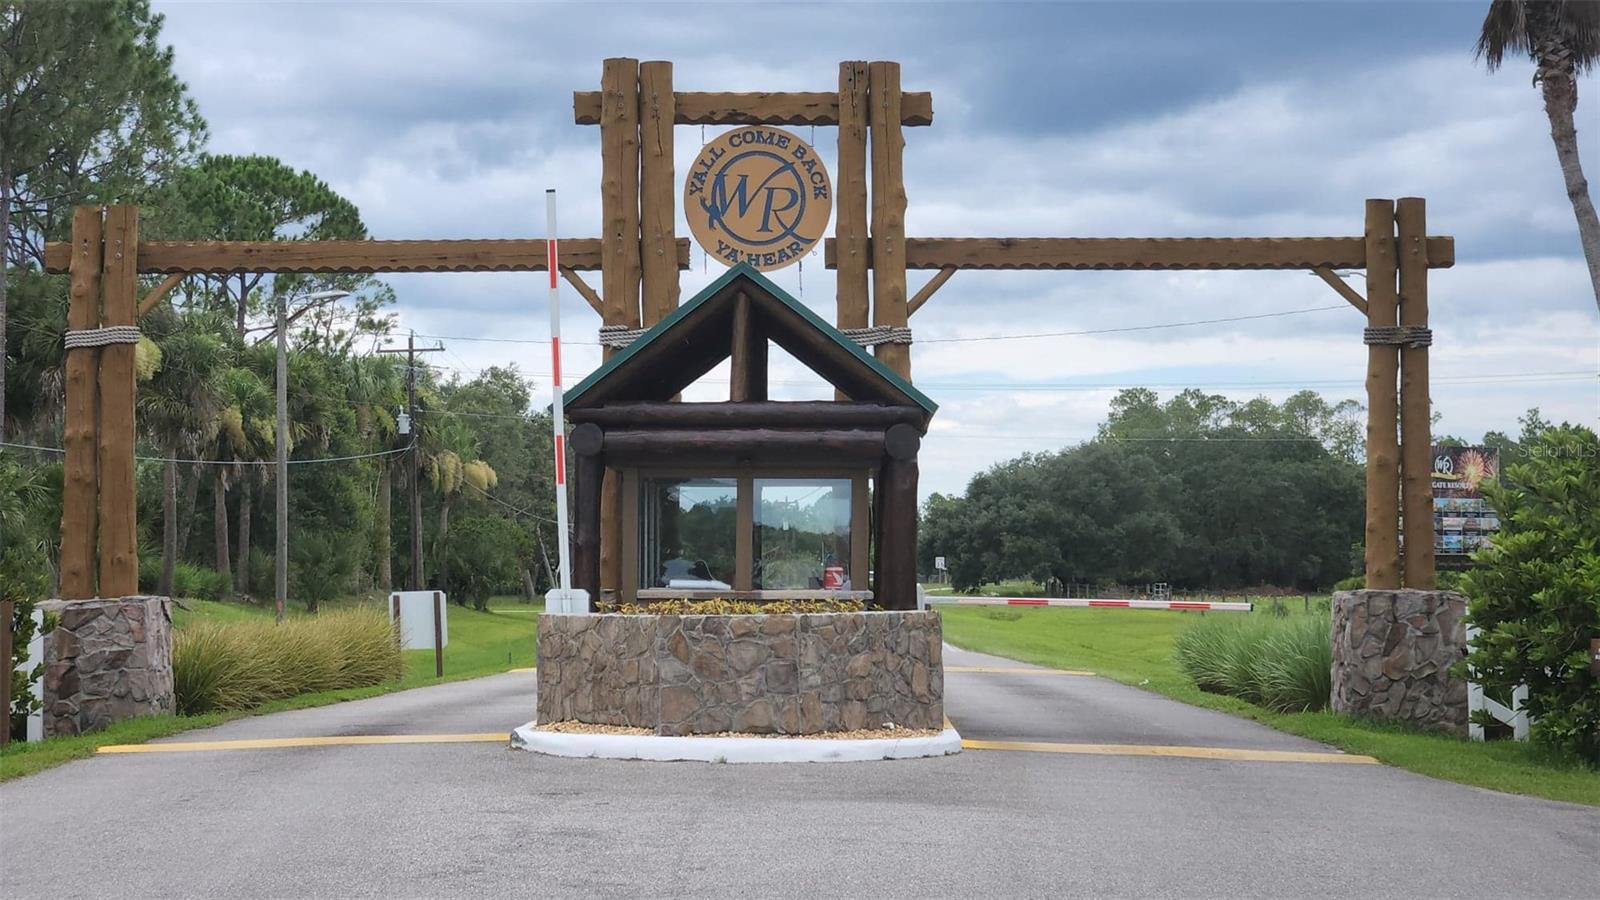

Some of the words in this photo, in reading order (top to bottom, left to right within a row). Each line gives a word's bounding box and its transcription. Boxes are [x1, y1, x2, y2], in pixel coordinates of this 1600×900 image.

[689, 147, 727, 196] YALL
[729, 130, 792, 150] COME
[792, 144, 828, 200] BACK
